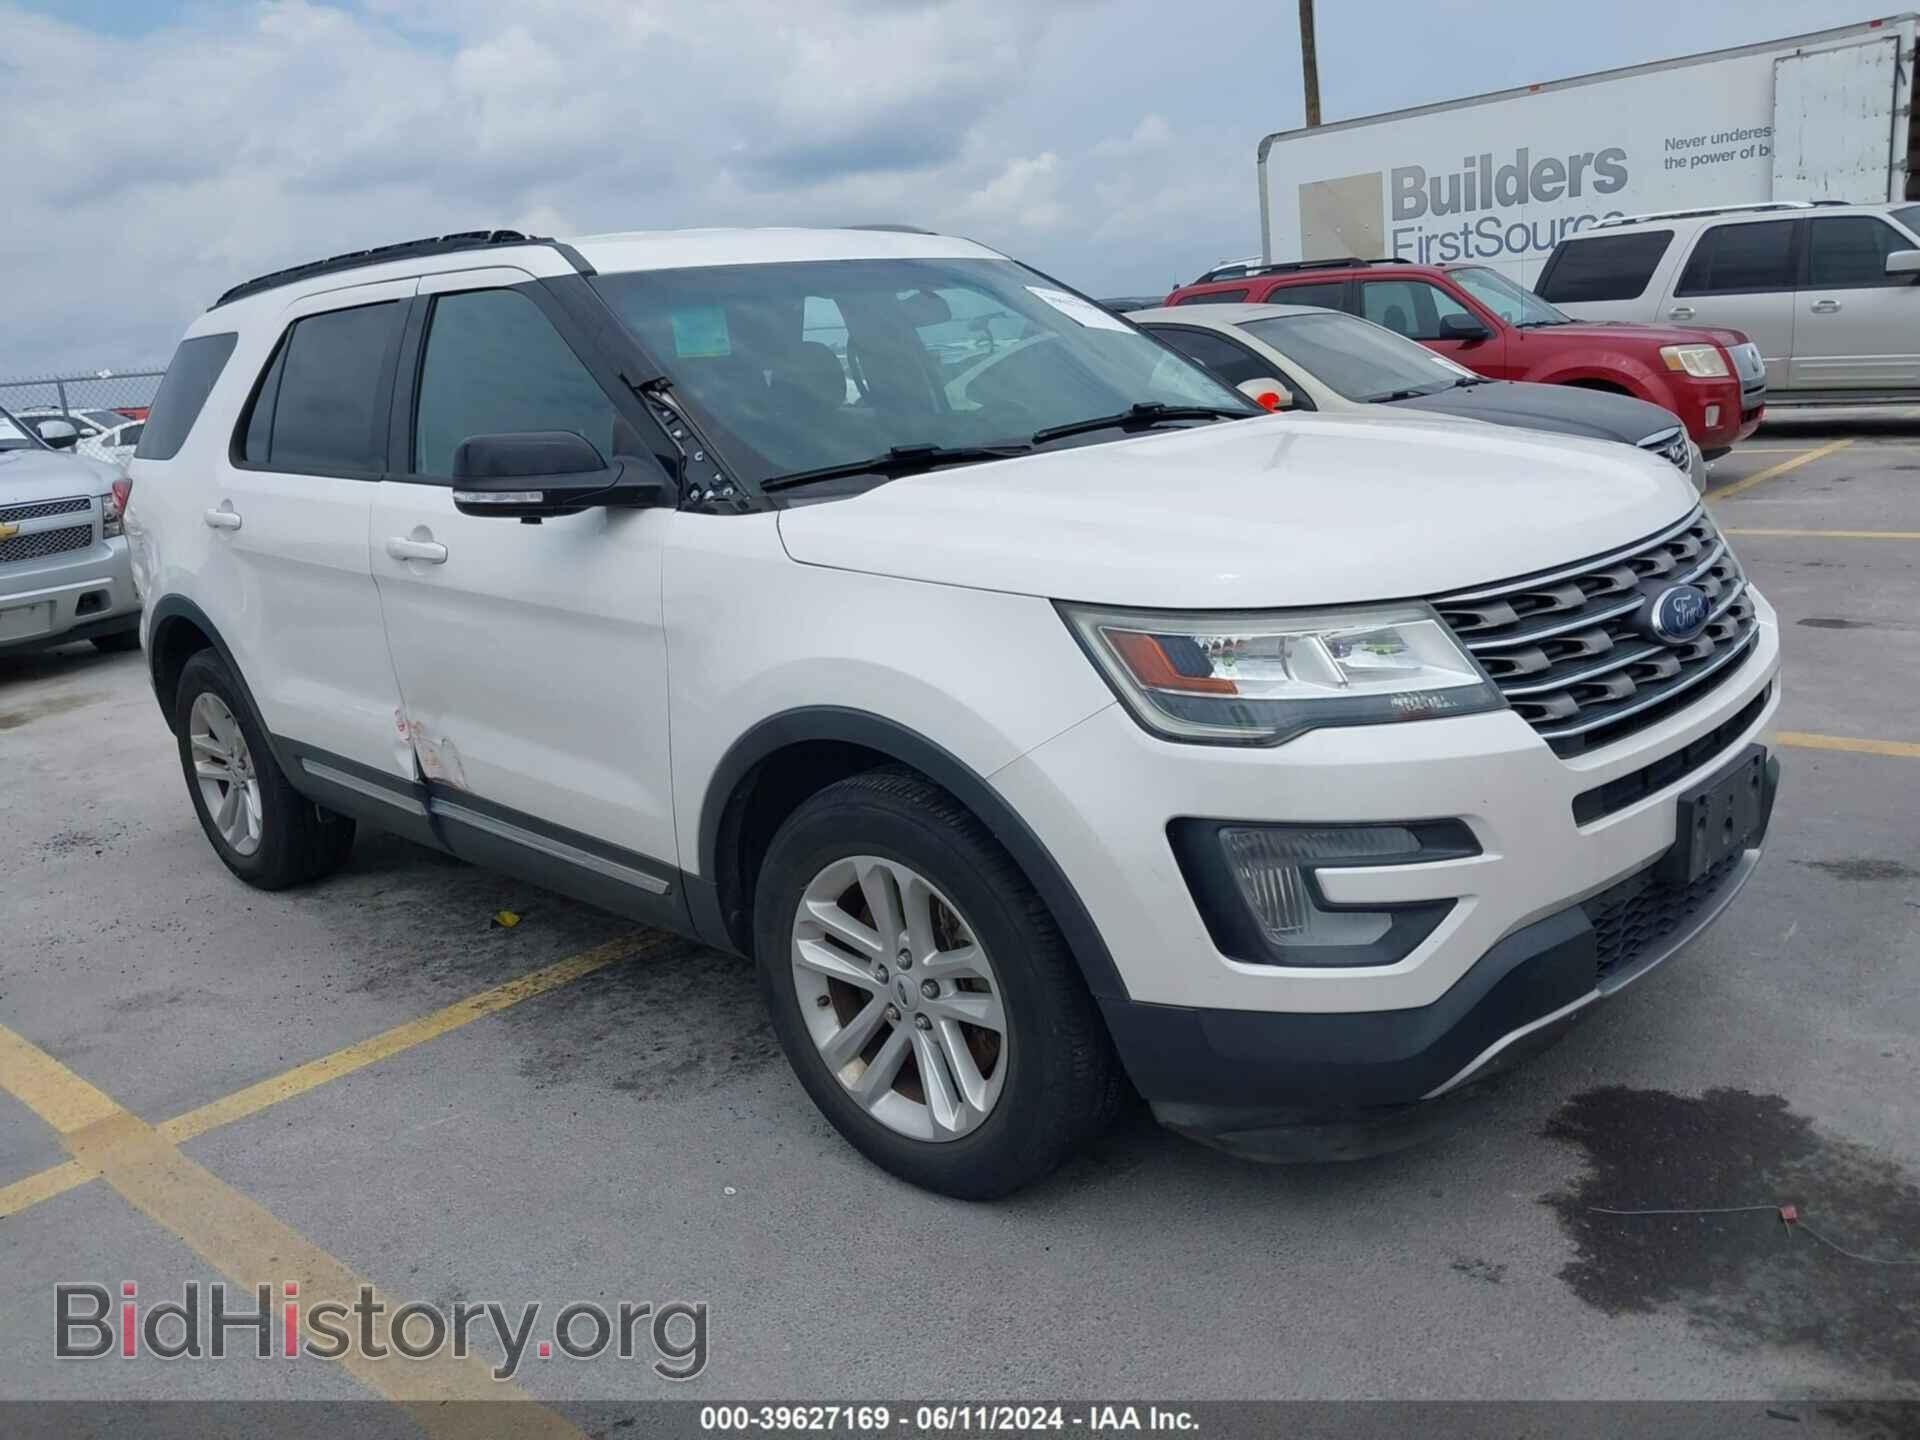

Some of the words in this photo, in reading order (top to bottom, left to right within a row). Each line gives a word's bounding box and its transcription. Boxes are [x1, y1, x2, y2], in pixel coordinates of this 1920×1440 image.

[1664, 136, 1707, 151] Never
[1664, 156, 1687, 170] the
[1690, 150, 1736, 170] power
[1740, 144, 1756, 159] of
[1391, 147, 1628, 222] Builders
[1392, 211, 1625, 265] FirstSour
